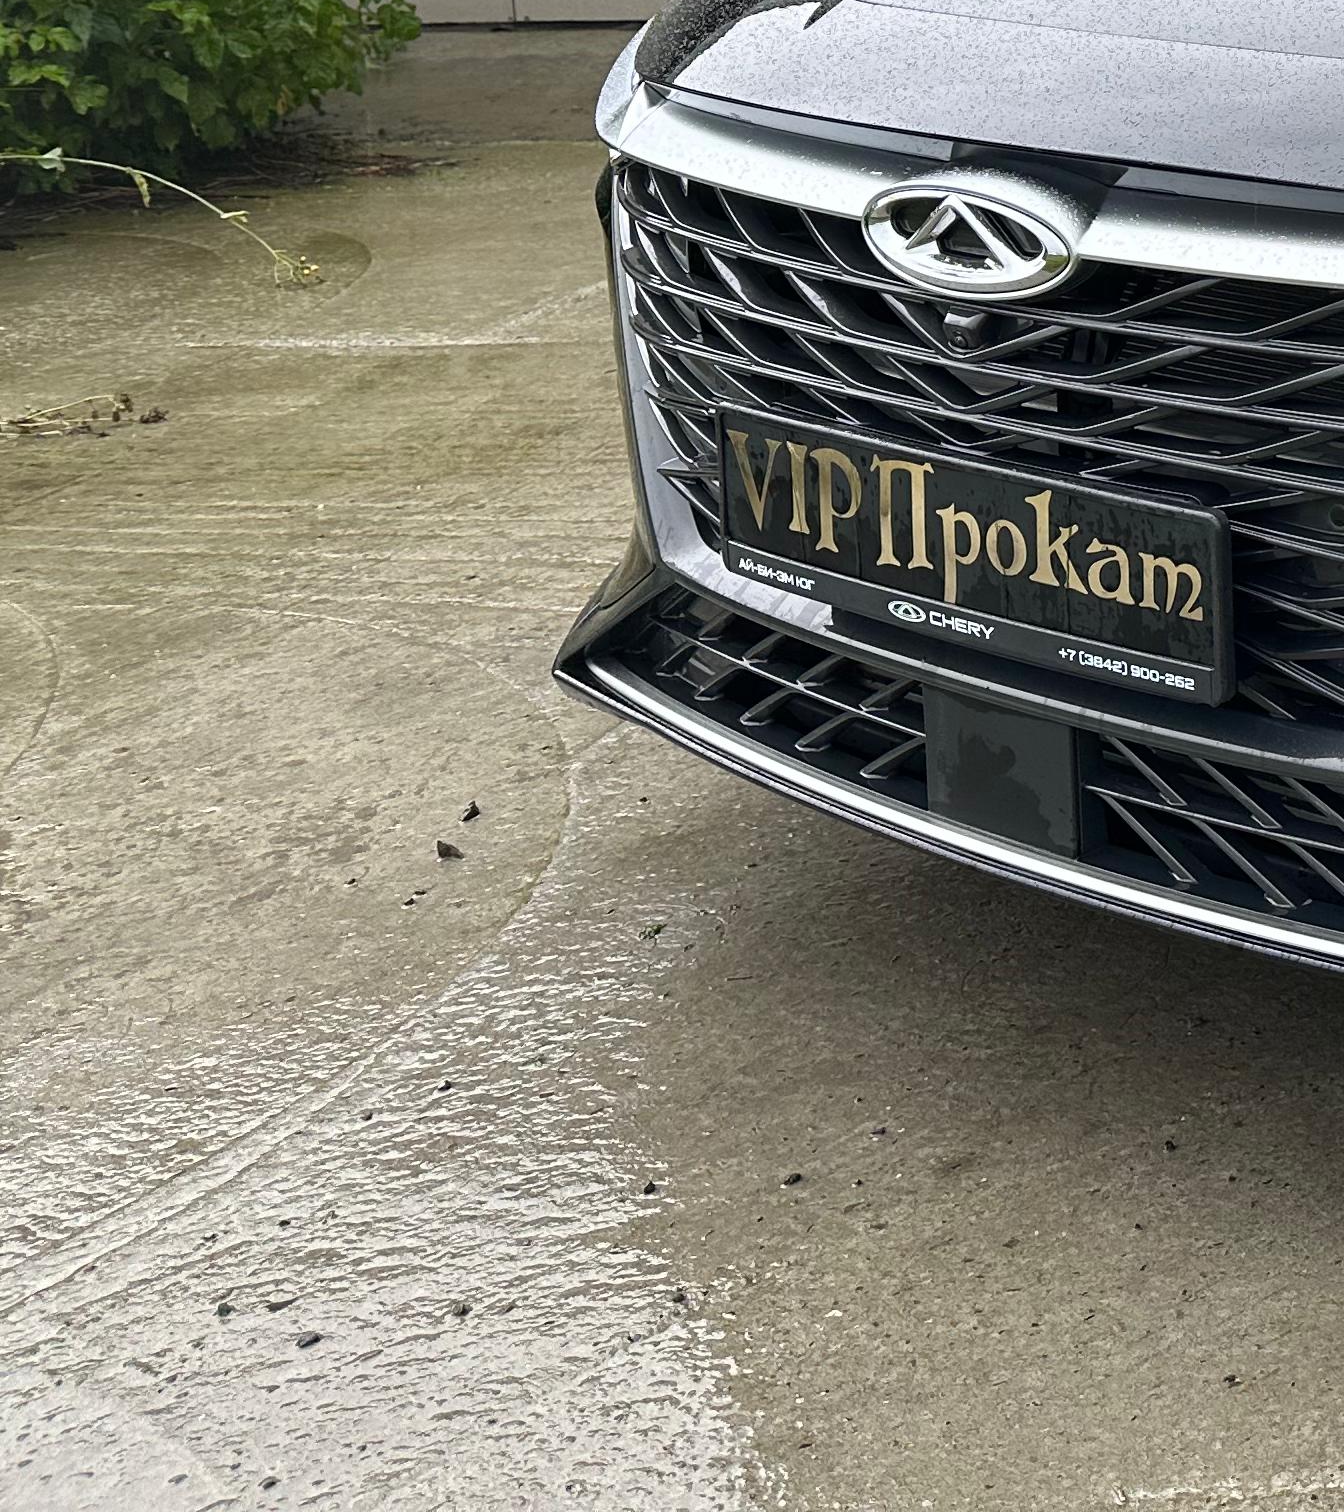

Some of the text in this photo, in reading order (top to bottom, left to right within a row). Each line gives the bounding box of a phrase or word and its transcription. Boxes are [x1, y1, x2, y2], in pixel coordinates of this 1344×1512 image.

[727, 430, 862, 553] VIP
[929, 610, 995, 640] CHERY
[1058, 647, 1196, 691] +7 (3842) 900-262
